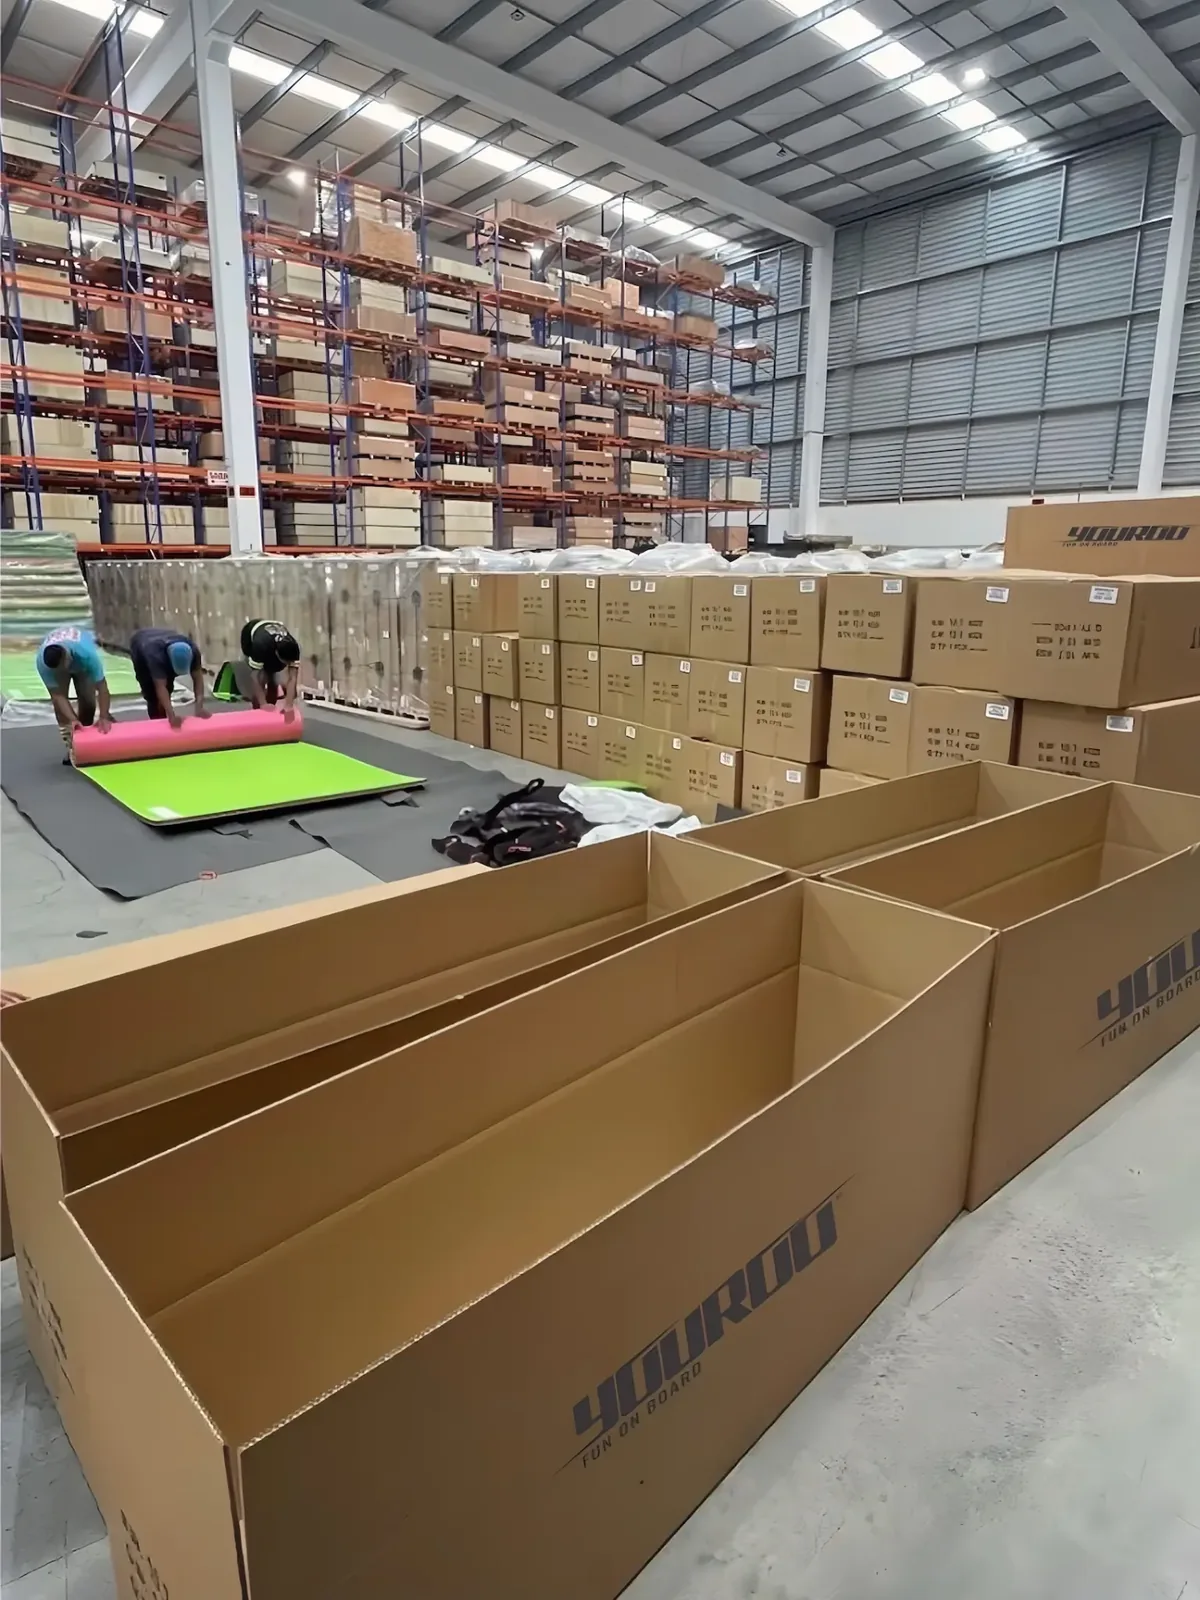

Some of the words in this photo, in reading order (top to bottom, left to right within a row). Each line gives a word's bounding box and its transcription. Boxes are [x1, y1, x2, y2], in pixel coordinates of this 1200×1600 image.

[1132, 1005, 1151, 1027] ON
[582, 1434, 613, 1469] FUN
[618, 1412, 640, 1438] ON
[647, 1361, 702, 1415] BOARD
